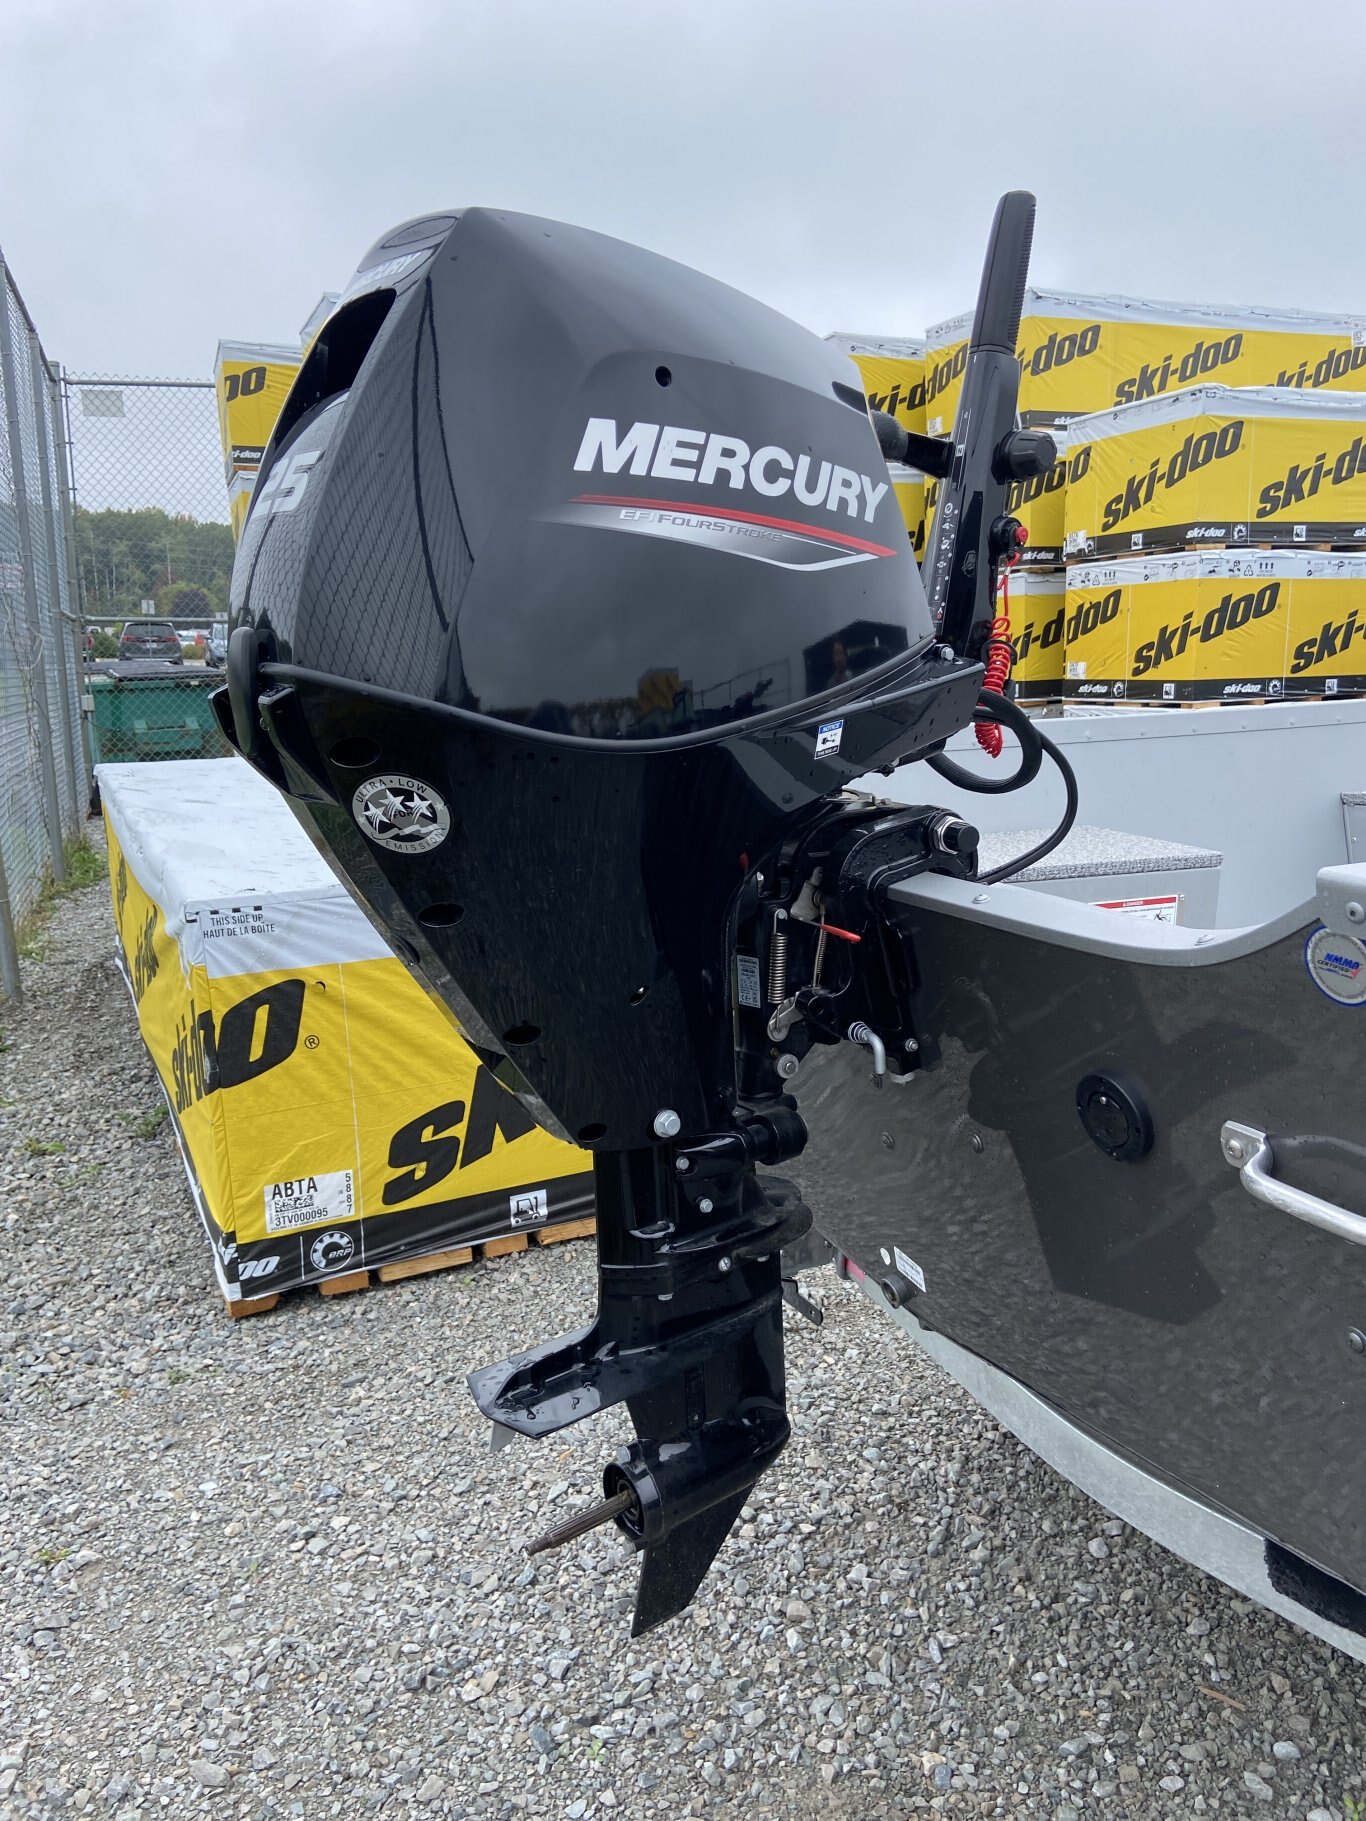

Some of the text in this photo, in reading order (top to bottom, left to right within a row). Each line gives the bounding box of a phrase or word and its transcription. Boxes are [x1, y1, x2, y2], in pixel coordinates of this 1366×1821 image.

[1113, 334, 1244, 407] ski-doo
[573, 417, 888, 523] MERCURY
[1101, 420, 1244, 532] ski-doo
[1256, 436, 1366, 519] ski-d
[657, 513, 784, 543] FOURSTROKE
[1186, 527, 1226, 538] ski-doo
[1022, 552, 1055, 561] ski-doo
[1132, 582, 1280, 677] ski-doo
[1078, 685, 1107, 693] ski-doo
[1223, 684, 1262, 694] ski-doo
[355, 778, 427, 803] ULTRA LOW
[210, 914, 264, 926] THIS SIDE UP
[203, 928, 224, 939] HAUT
[227, 927, 238, 936] DE
[240, 926, 249, 935] LA
[272, 1177, 318, 1200] ABTA
[275, 1207, 328, 1227] 3TV000095
